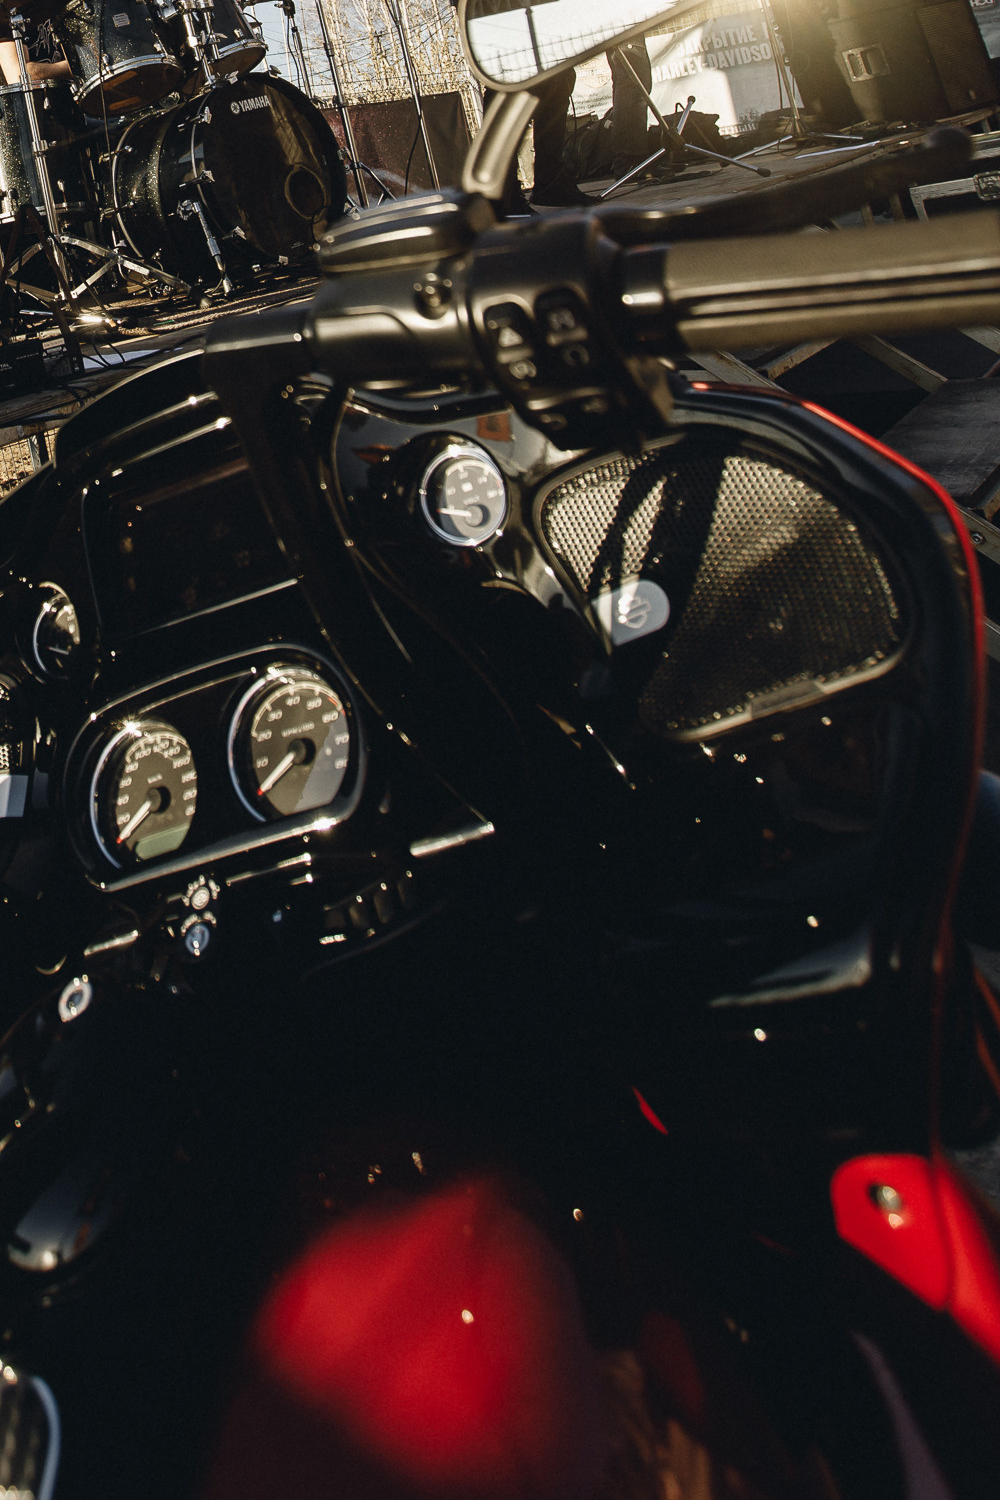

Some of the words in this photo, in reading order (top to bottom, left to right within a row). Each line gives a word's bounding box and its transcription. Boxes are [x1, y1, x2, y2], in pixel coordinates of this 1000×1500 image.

[652, 42, 773, 83] HARLEY-DAVIDSO
[239, 95, 270, 112] YAMAHA
[285, 694, 301, 707] 40
